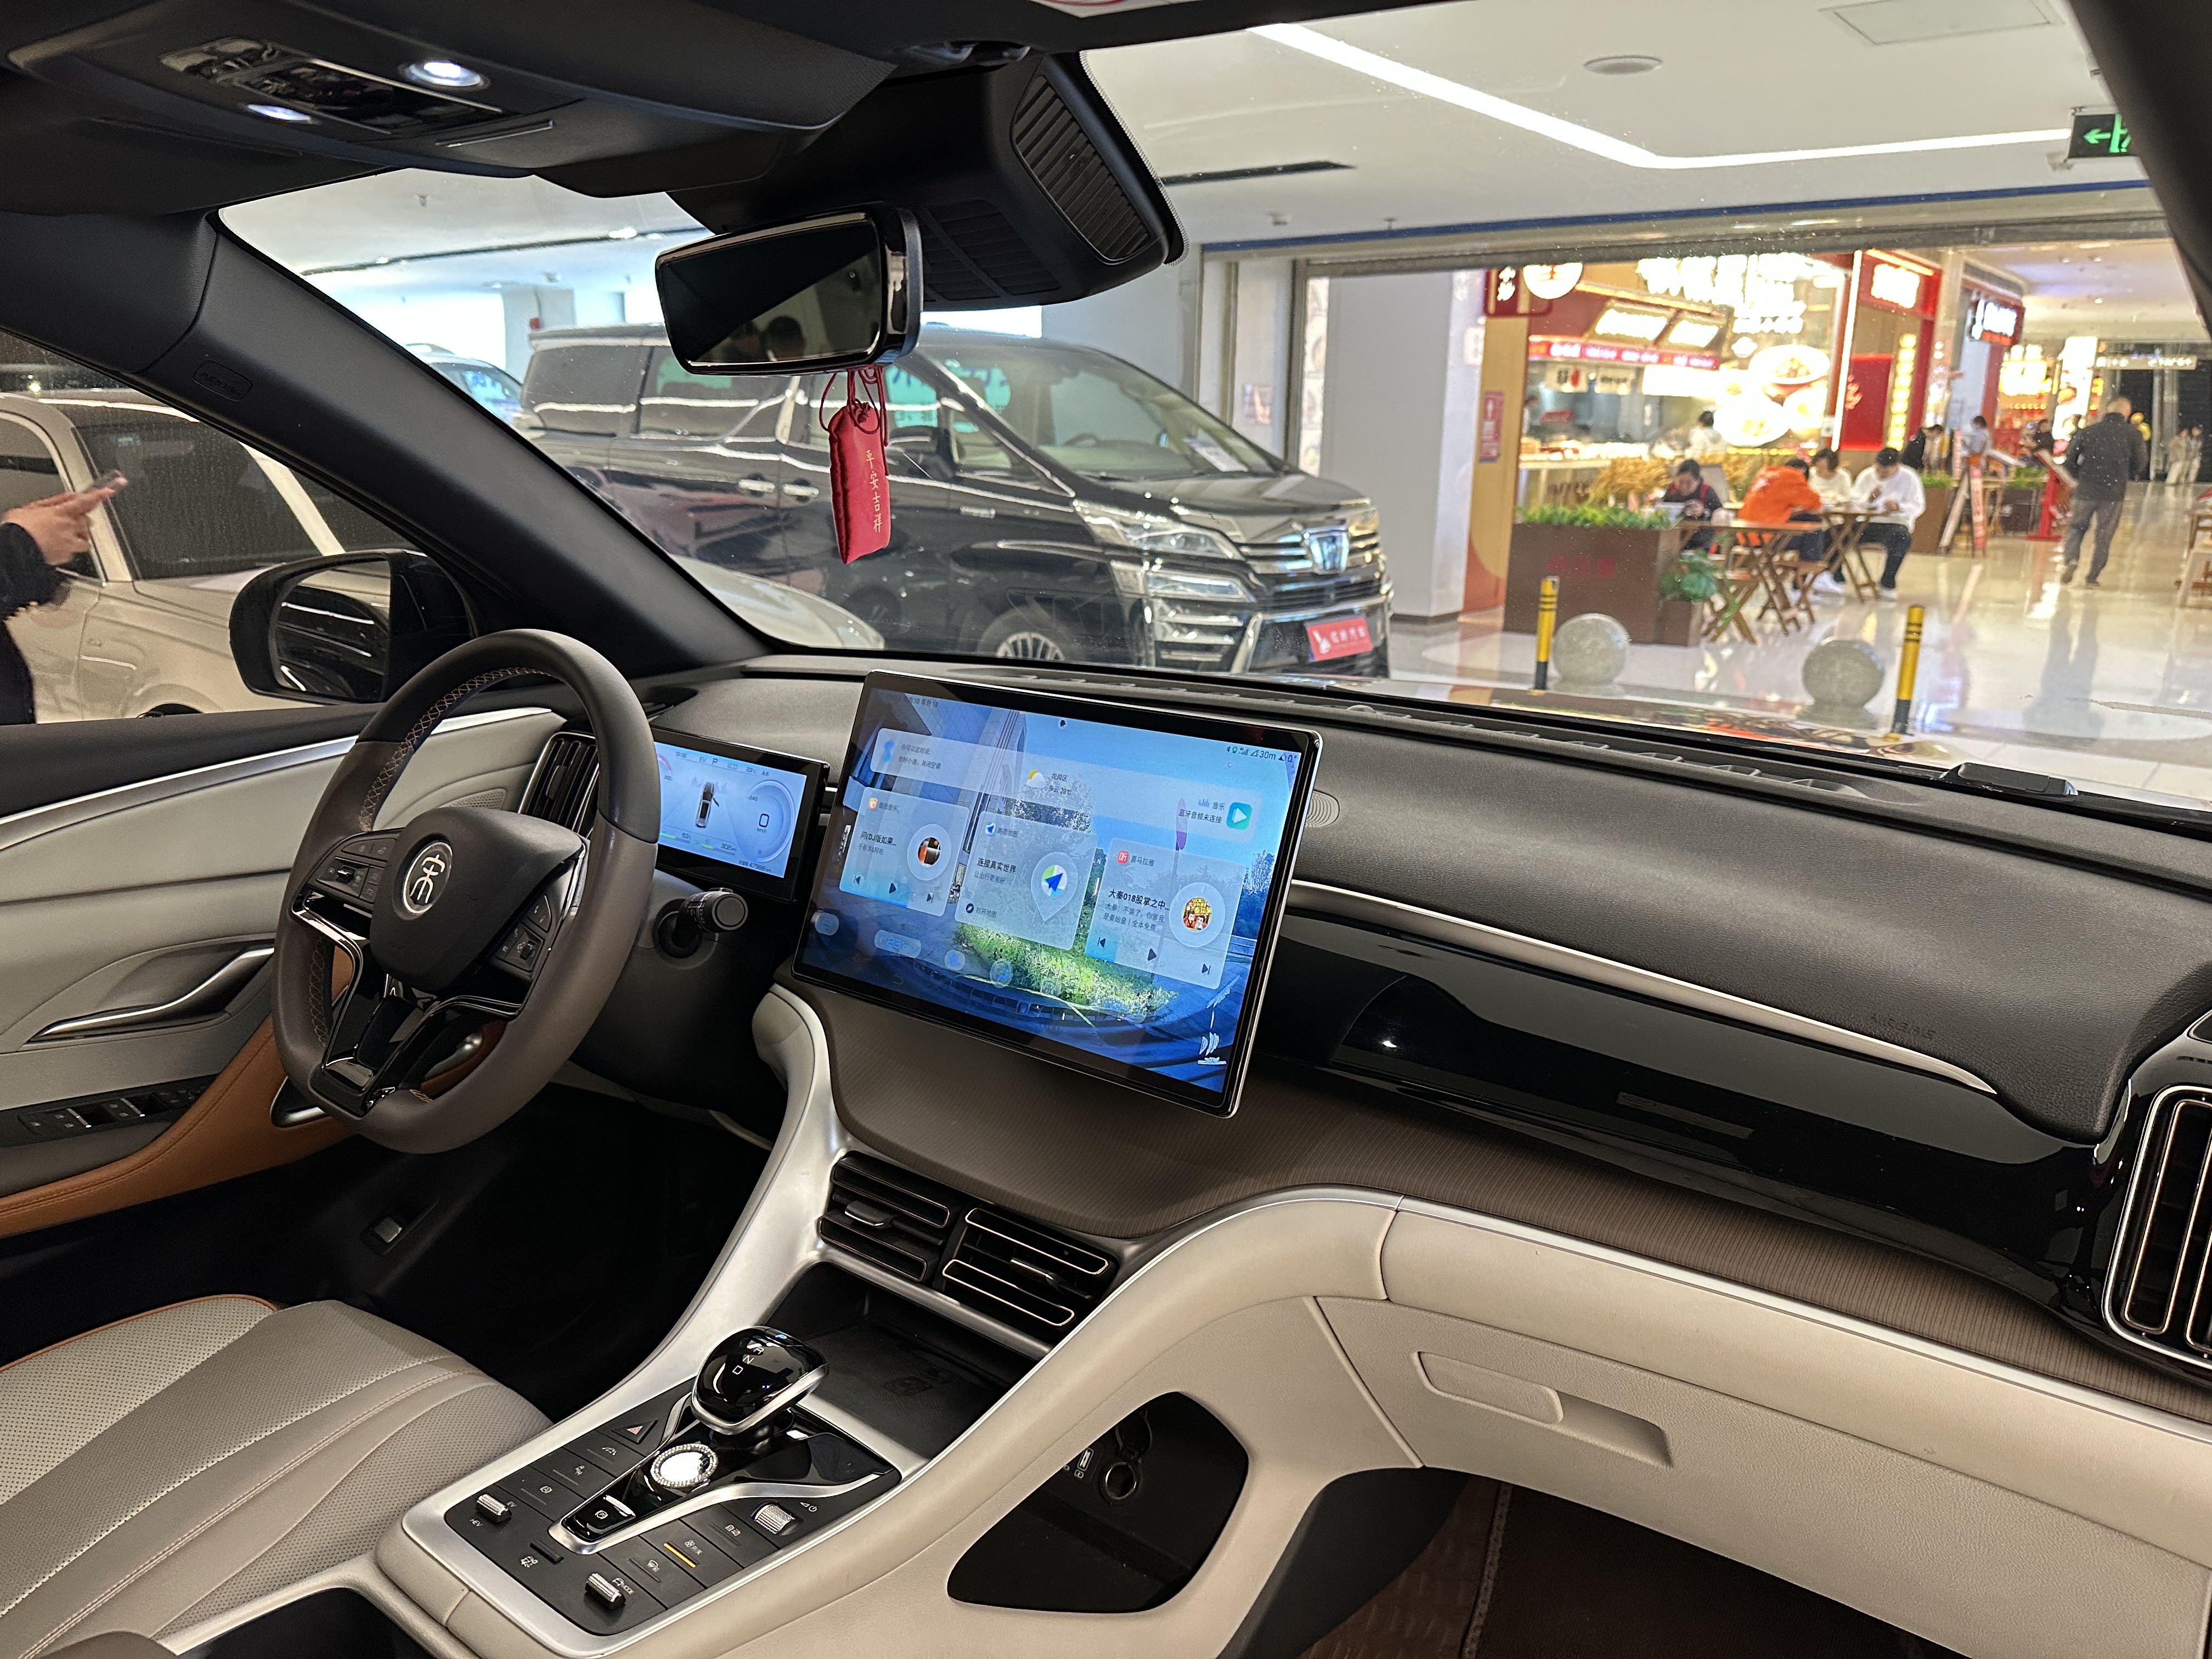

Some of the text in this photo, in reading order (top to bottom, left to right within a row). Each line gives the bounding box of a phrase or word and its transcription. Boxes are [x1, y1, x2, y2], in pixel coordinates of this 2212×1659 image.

[866, 449, 882, 533] 平安吉祥
[1259, 751, 1276, 760] 30m
[1048, 785, 1059, 793] 多云
[1212, 802, 1225, 810] 音乐
[759, 813, 770, 827] 0
[1178, 809, 1222, 824] 蓝牙音频未连接
[997, 827, 1018, 838] 高德地图
[977, 857, 1017, 874] 连接真实世界
[1131, 855, 1155, 866] 喜马拉雅
[974, 871, 1005, 884] 让出行更美好
[976, 907, 997, 918] 打开地图
[753, 1346, 764, 1355] R
[742, 1355, 755, 1364] N
[732, 1365, 743, 1375] D
[469, 1518, 483, 1527] HEV
[725, 1523, 741, 1538] 自动
[620, 1583, 635, 1594] MODE
